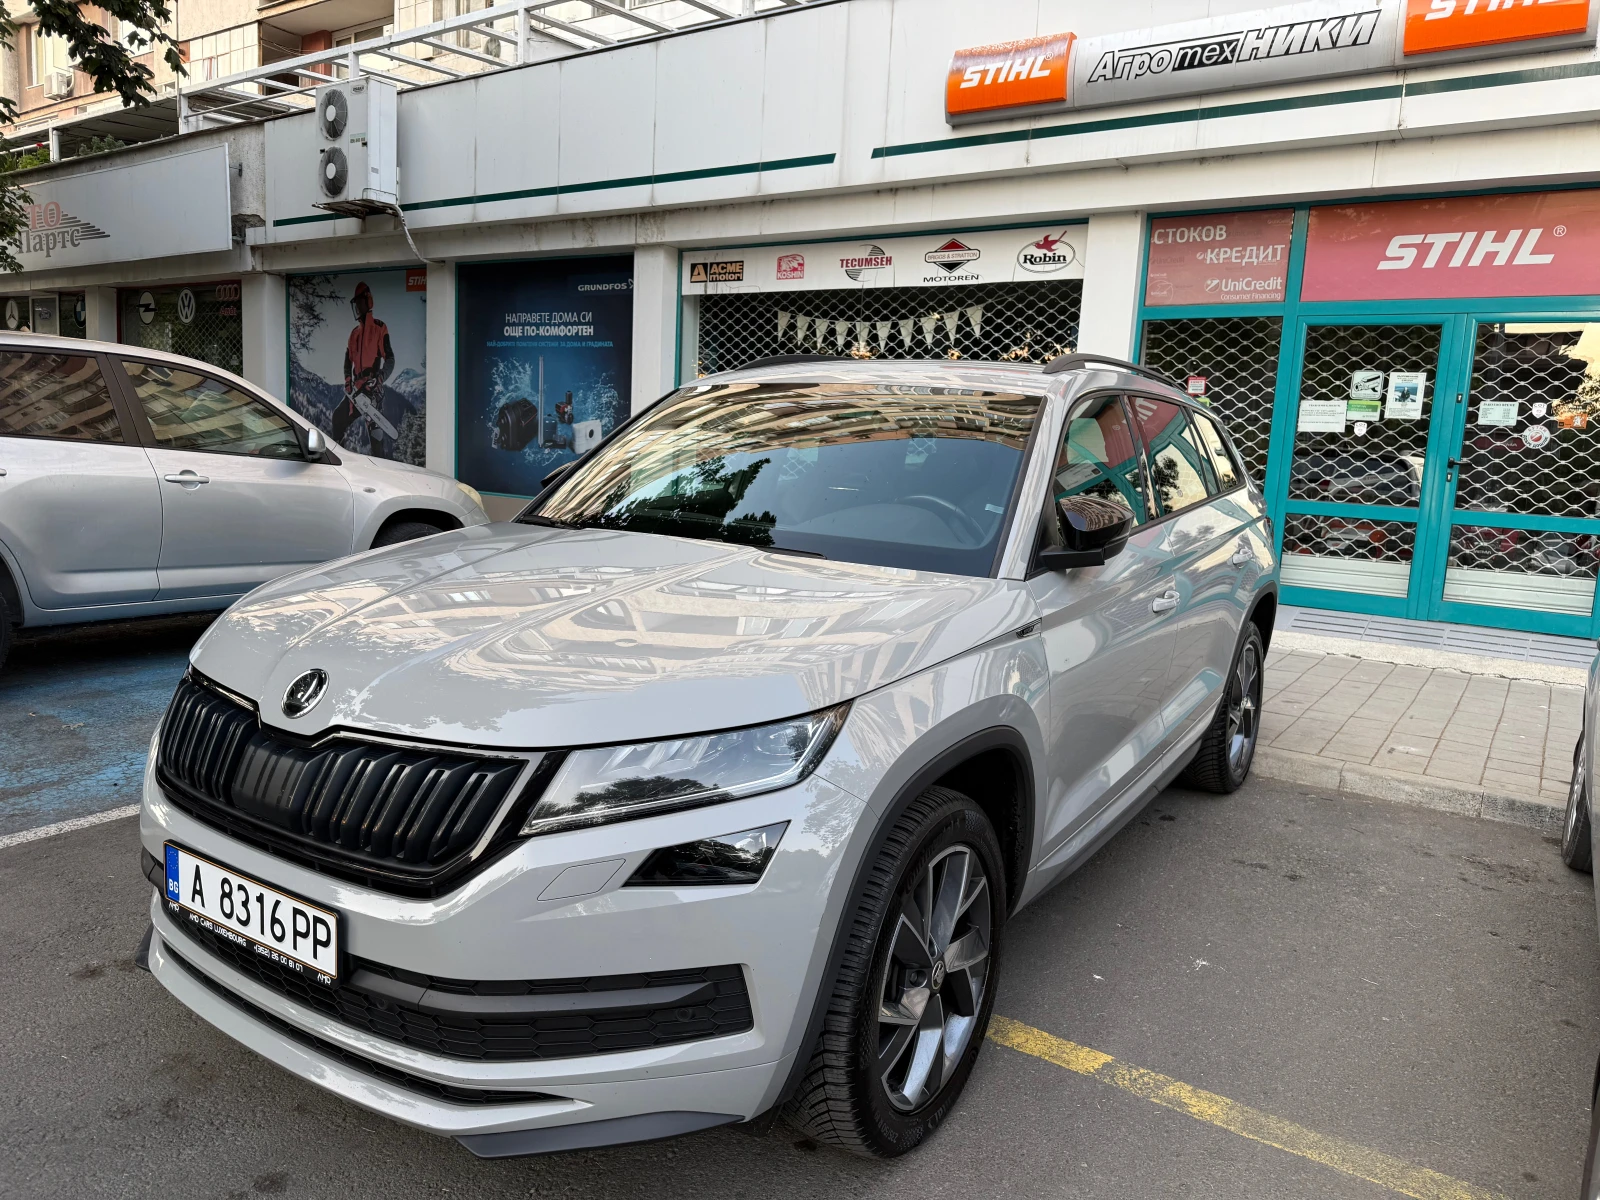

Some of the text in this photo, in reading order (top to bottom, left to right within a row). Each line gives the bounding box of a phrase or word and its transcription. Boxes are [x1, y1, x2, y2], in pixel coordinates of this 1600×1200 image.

[959, 55, 1051, 89] STIHL
[1153, 225, 1228, 245] СТОКОВ
[1206, 245, 1286, 267] КРЕДИТ
[1376, 228, 1555, 270] STIHL
[840, 256, 893, 268] TECUMSEH
[927, 253, 946, 261] BRIGGS
[951, 252, 978, 260] STRATTON
[1022, 252, 1067, 265] Robin
[710, 263, 743, 274] ACME
[776, 271, 804, 279] KOSHIN
[709, 273, 743, 281] motori
[923, 274, 979, 283] MOTOREN
[1221, 276, 1283, 292] UniCredit
[577, 282, 628, 291] GRUNDFOS
[1220, 291, 1281, 301] Consumer Financing
[505, 311, 592, 325] НАПРАВЕТЕ ДОМА СИ
[503, 324, 594, 338] ОЩЕ ПО-КОМФОРТЕН
[168, 878, 179, 894] BG
[191, 864, 206, 909] A
[213, 924, 247, 947] LUXEMBOURG
